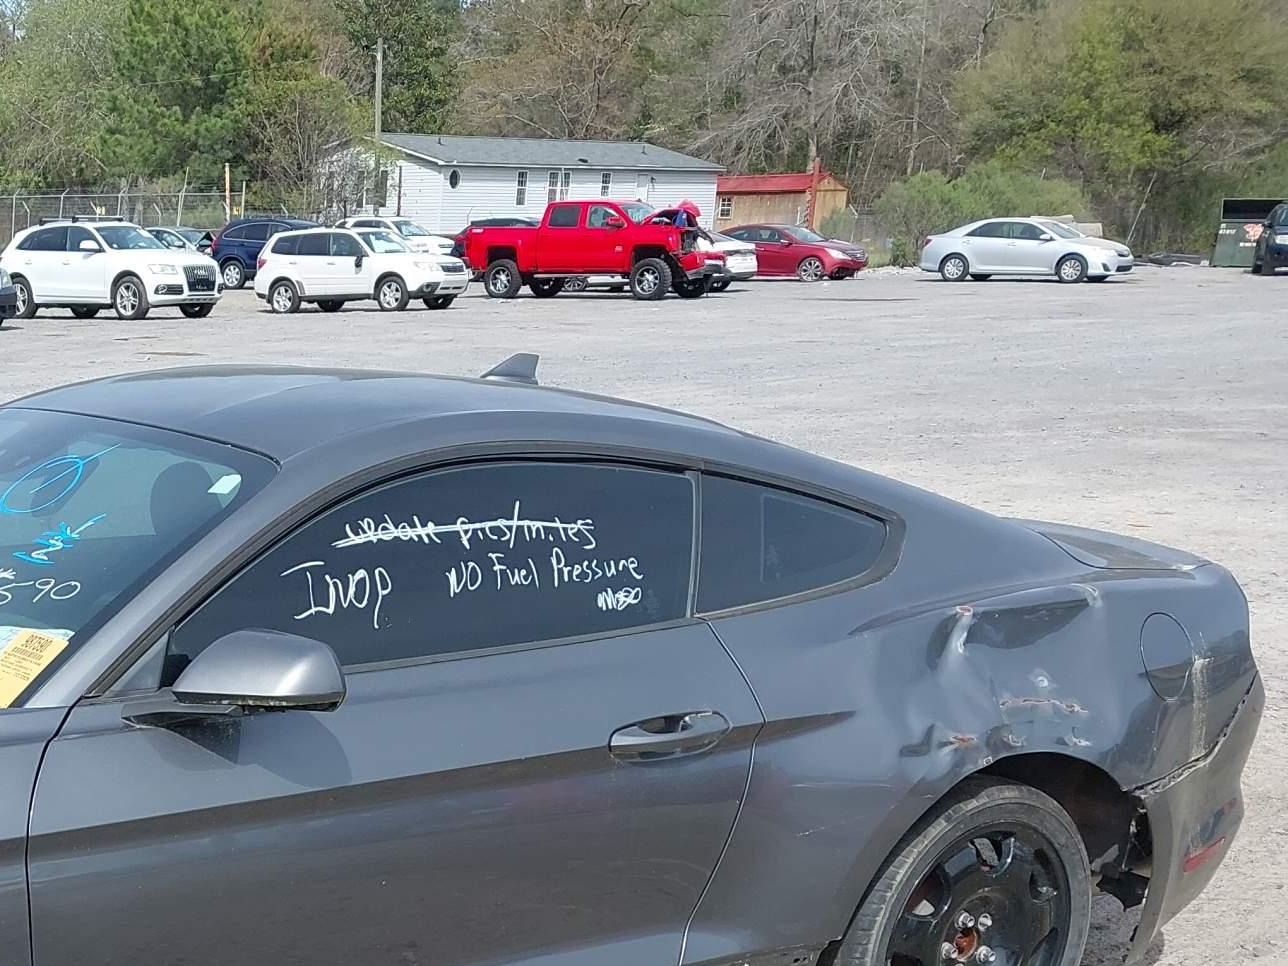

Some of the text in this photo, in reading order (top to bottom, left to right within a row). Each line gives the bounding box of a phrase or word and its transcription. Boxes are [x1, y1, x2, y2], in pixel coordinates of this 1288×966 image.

[445, 547, 643, 597] NO Fuel Pressure
